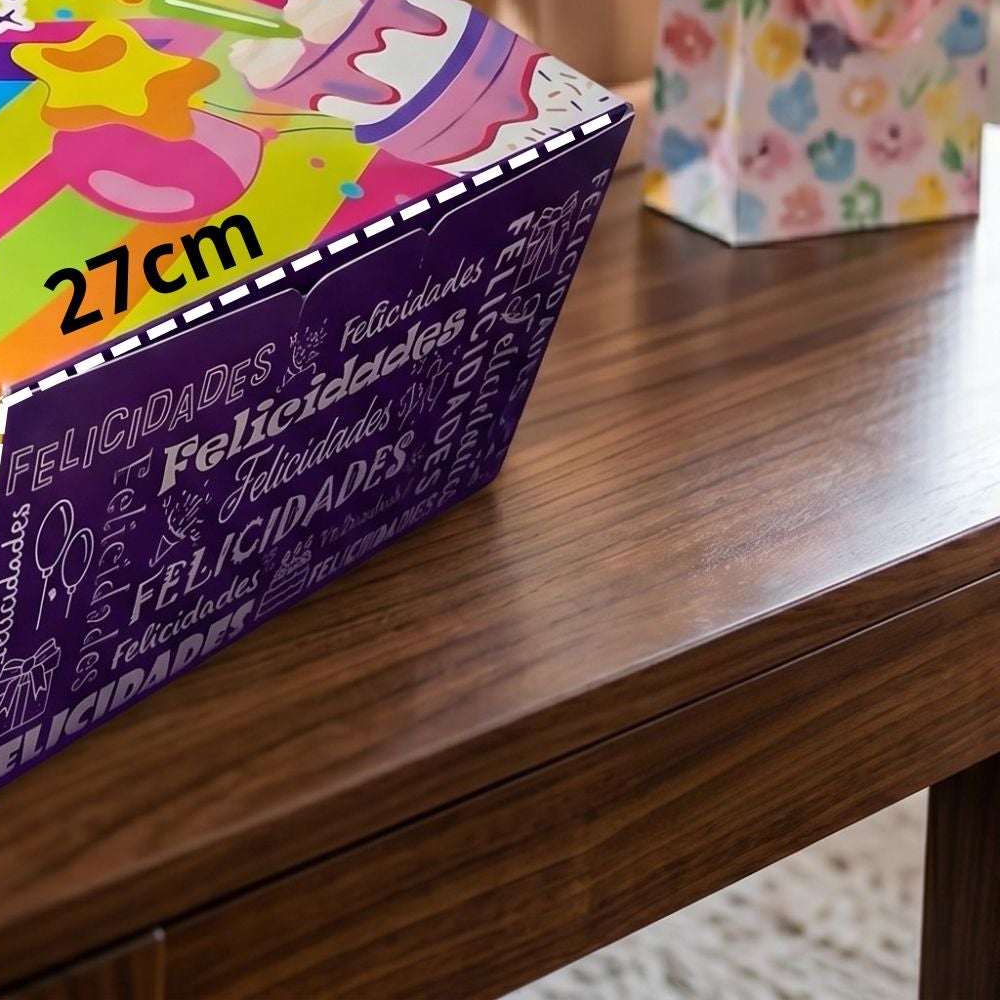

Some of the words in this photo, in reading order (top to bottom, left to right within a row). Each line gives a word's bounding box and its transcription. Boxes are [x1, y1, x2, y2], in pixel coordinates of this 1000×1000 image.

[339, 257, 485, 352] Felicidades
[415, 210, 536, 496] FELICIDADES
[5, 342, 276, 497] FELICIDADES
[156, 307, 467, 497] Felicidades
[218, 395, 392, 525] Felicidades
[128, 430, 415, 627] FELICIDADES
[110, 568, 262, 671] Felicidades
